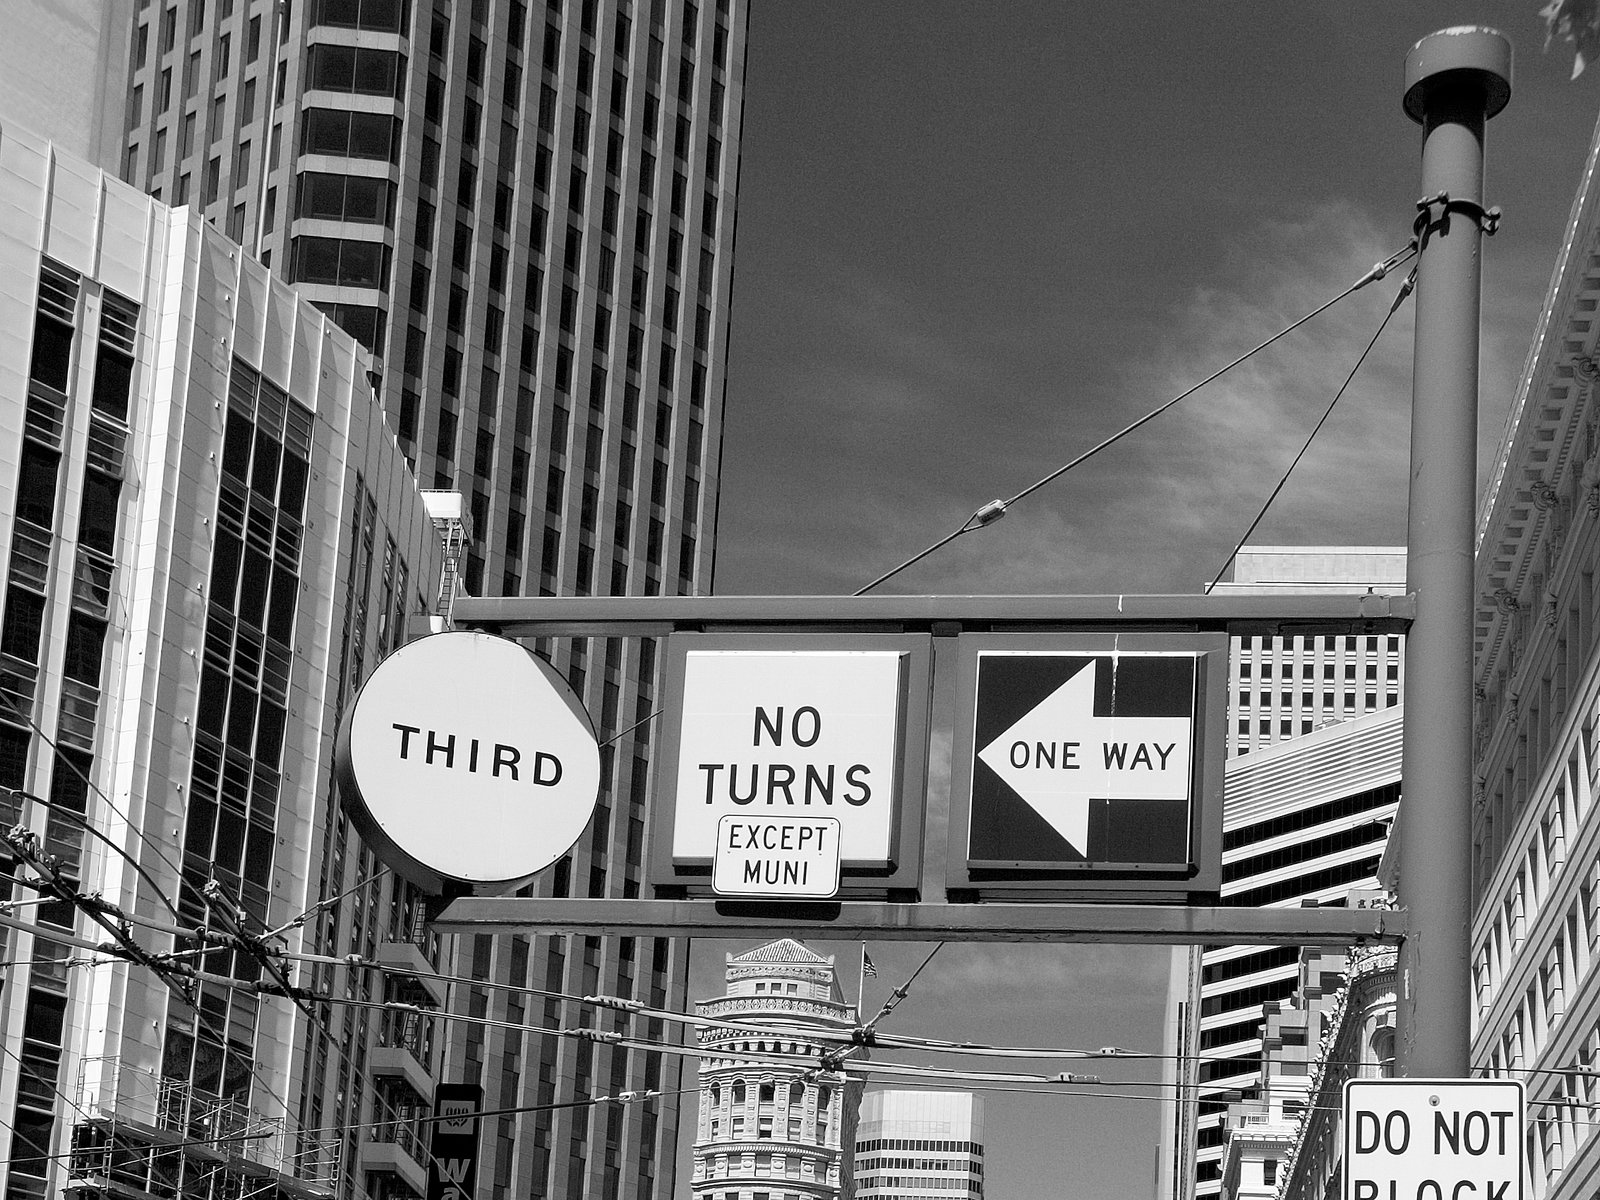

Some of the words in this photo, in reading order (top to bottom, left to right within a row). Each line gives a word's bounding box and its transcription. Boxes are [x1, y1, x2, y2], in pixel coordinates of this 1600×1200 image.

[753, 705, 822, 747] NO
[391, 722, 564, 788] THIRD
[1008, 740, 1081, 770] ONE
[1102, 742, 1177, 771] WAY
[698, 763, 872, 807] TURNS
[729, 823, 829, 852] EXCEPT
[743, 859, 809, 887] MUNI
[1355, 1110, 1411, 1155] DO
[1433, 1110, 1514, 1156] NOT
